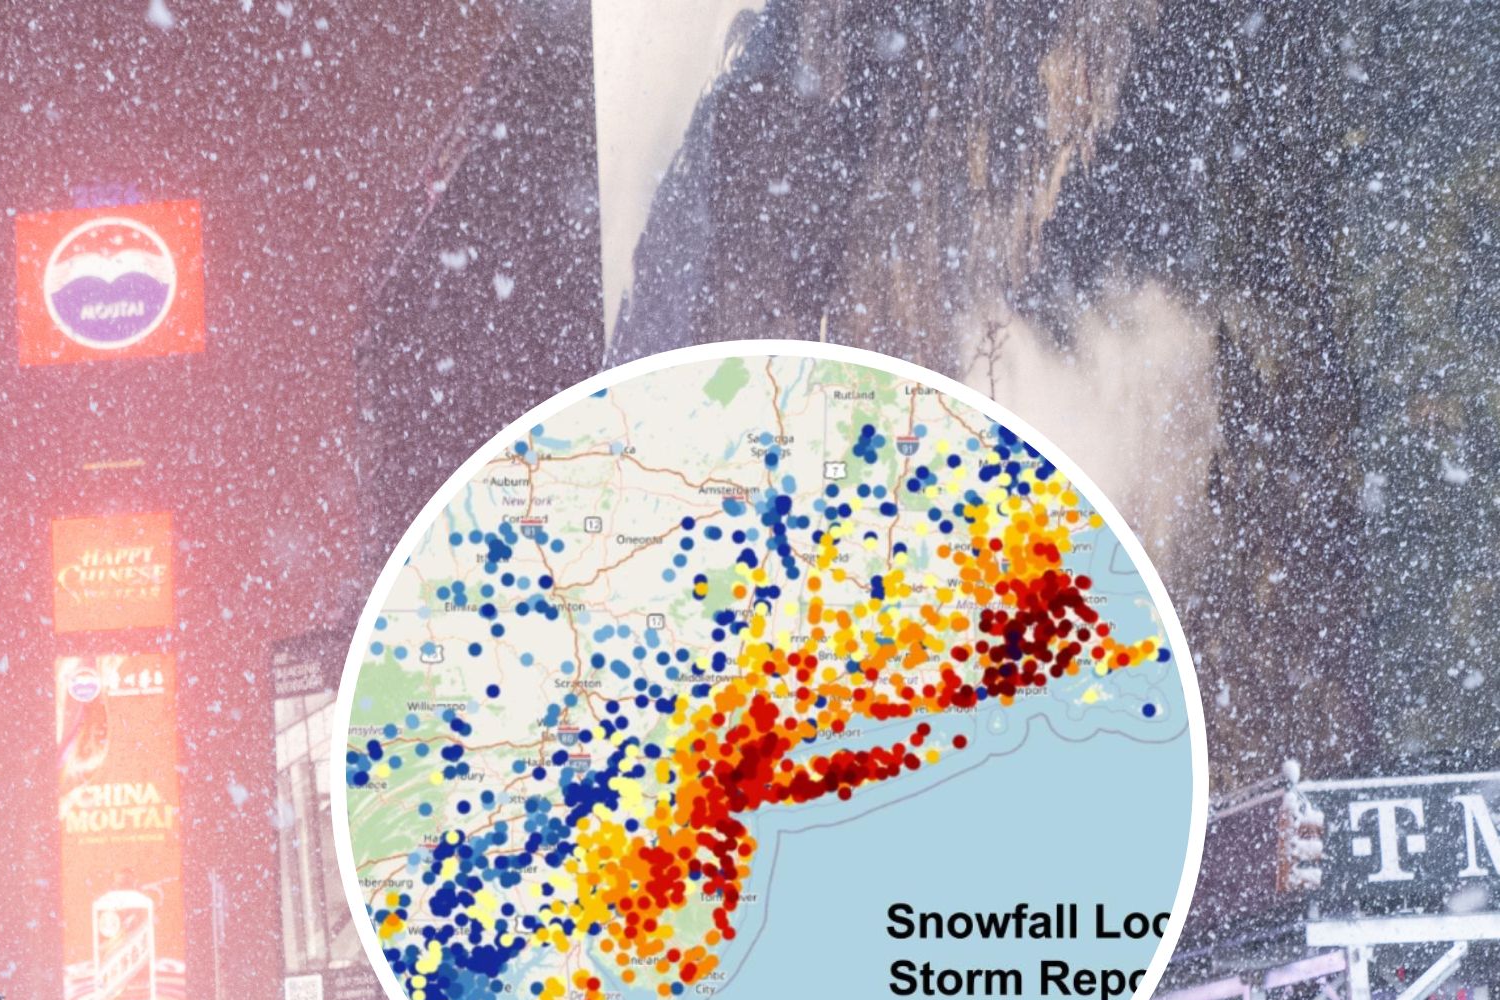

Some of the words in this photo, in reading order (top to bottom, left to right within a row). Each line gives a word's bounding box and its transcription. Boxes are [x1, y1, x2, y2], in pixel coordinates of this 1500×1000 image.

[81, 300, 145, 321] MOUTAI
[81, 547, 154, 566] HAPPY
[61, 783, 161, 820] CHINA
[66, 804, 174, 833] MOUTAI
